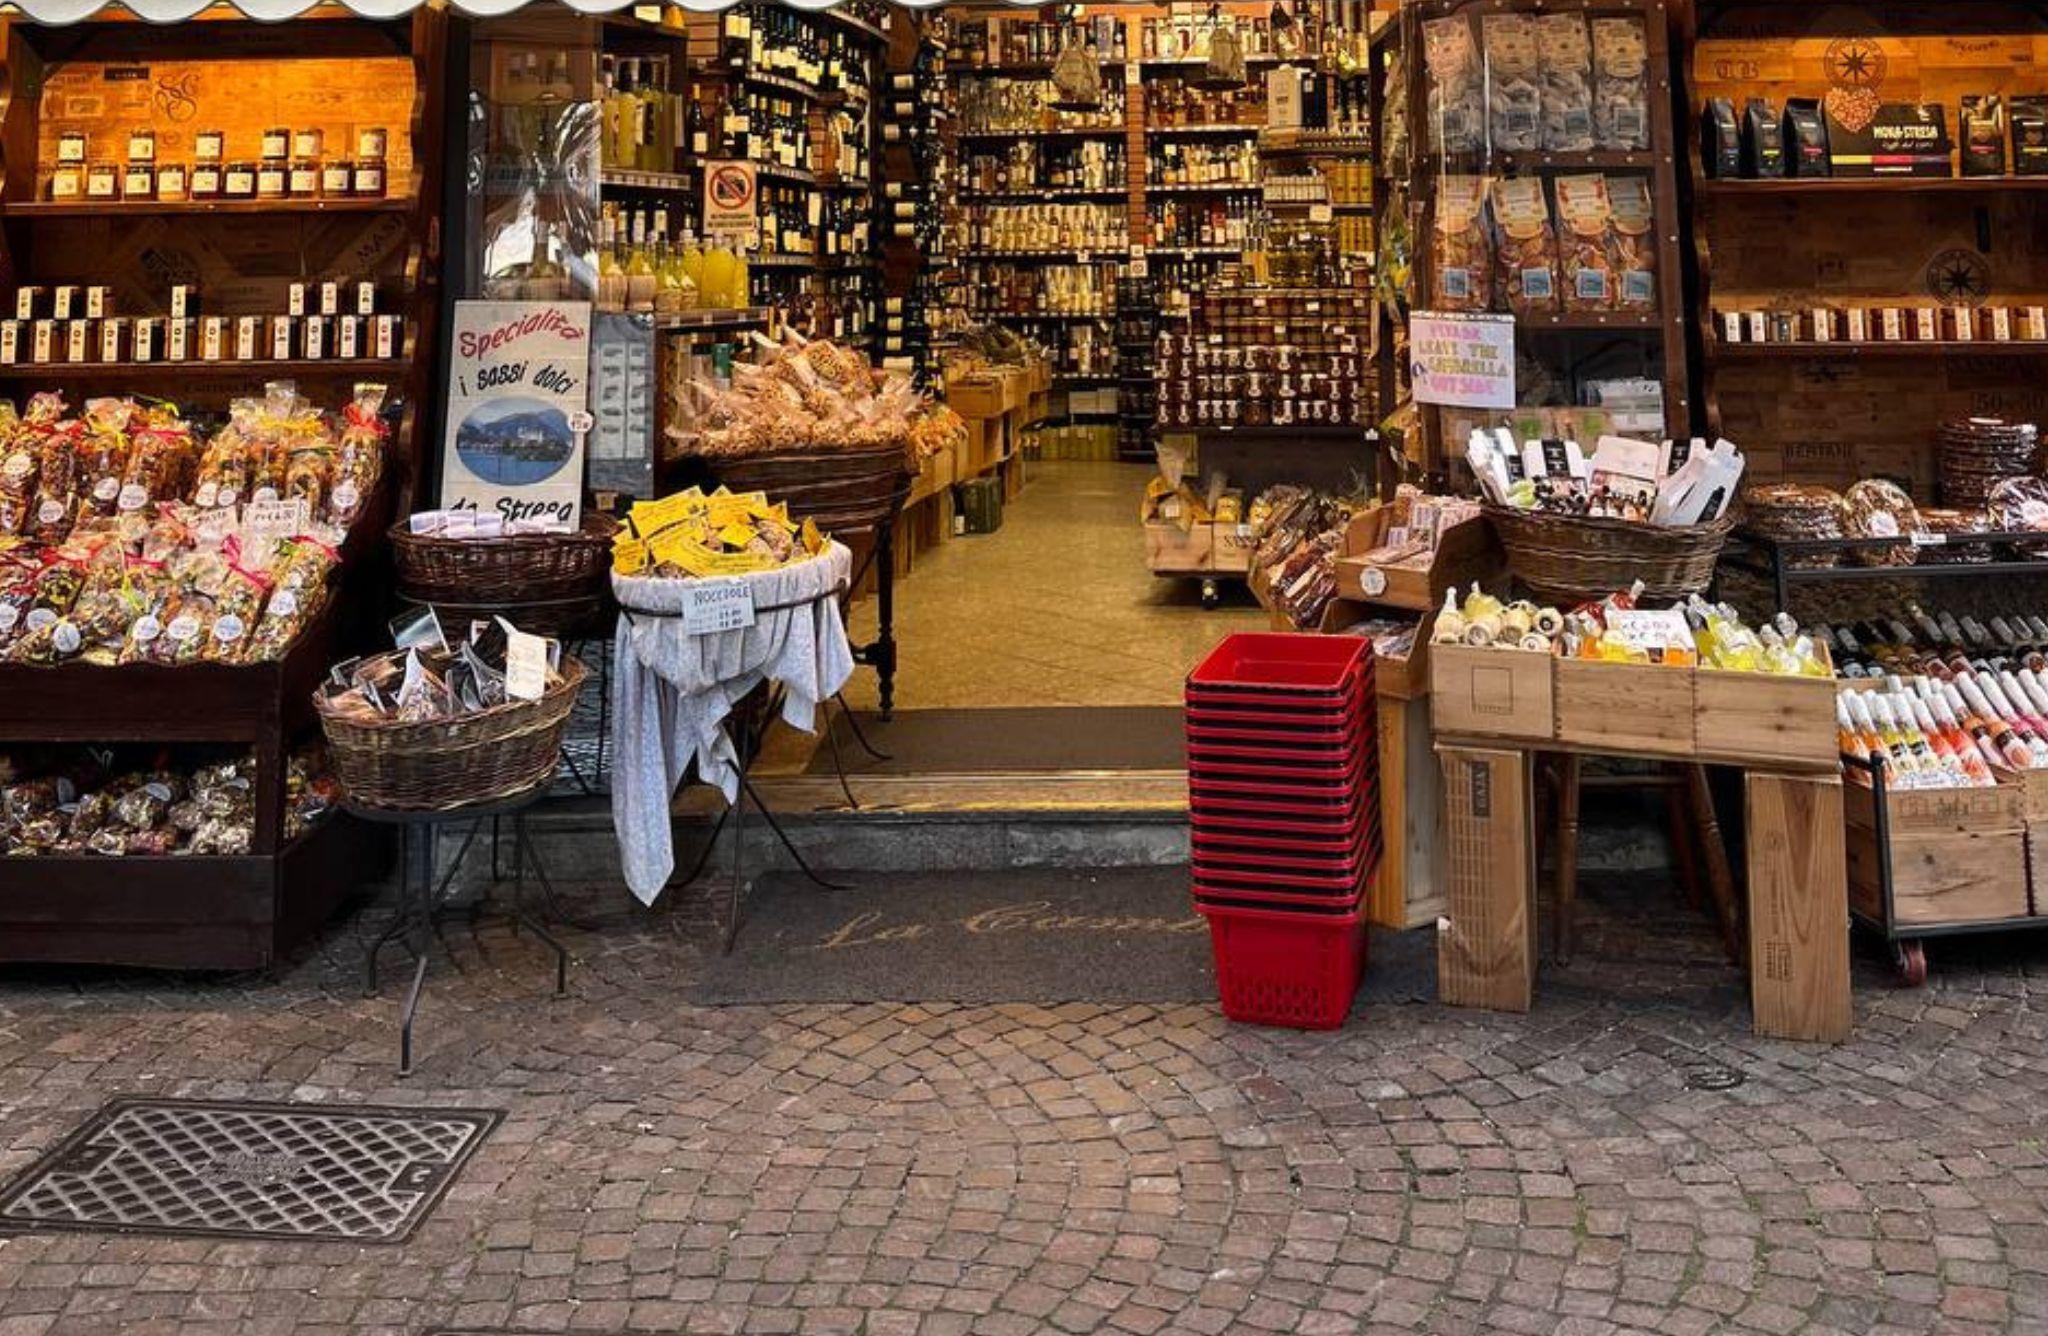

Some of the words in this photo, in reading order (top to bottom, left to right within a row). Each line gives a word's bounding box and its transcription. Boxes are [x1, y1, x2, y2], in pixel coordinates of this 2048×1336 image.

[1418, 340, 1457, 355] LEAVE
[1468, 343, 1499, 360] THE
[458, 376, 468, 397] i
[477, 360, 529, 391] sassi
[533, 364, 579, 395] dolci
